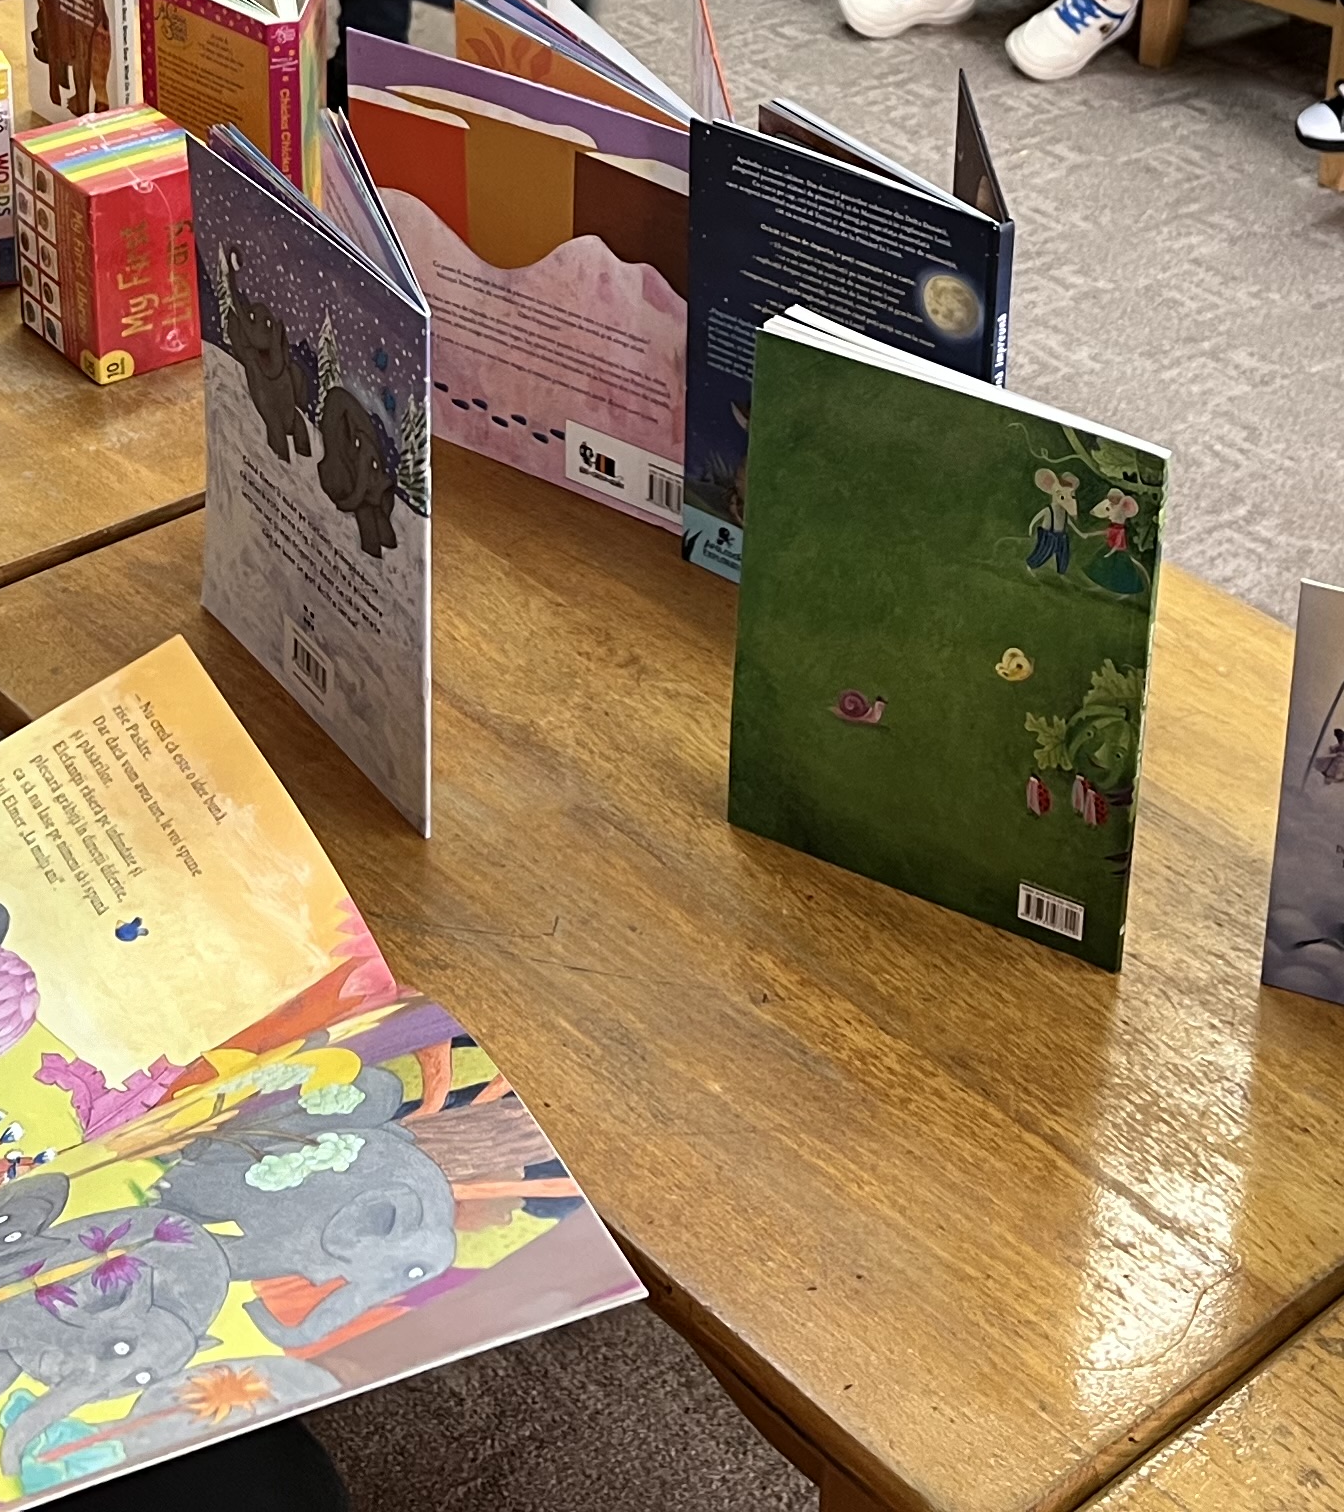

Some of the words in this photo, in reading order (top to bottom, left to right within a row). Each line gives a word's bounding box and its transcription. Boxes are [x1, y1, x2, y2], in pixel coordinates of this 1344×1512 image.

[278, 88, 291, 129] Chicka
[280, 131, 293, 172] Chicka
[120, 292, 160, 338] My
[92, 714, 110, 737] Dar
